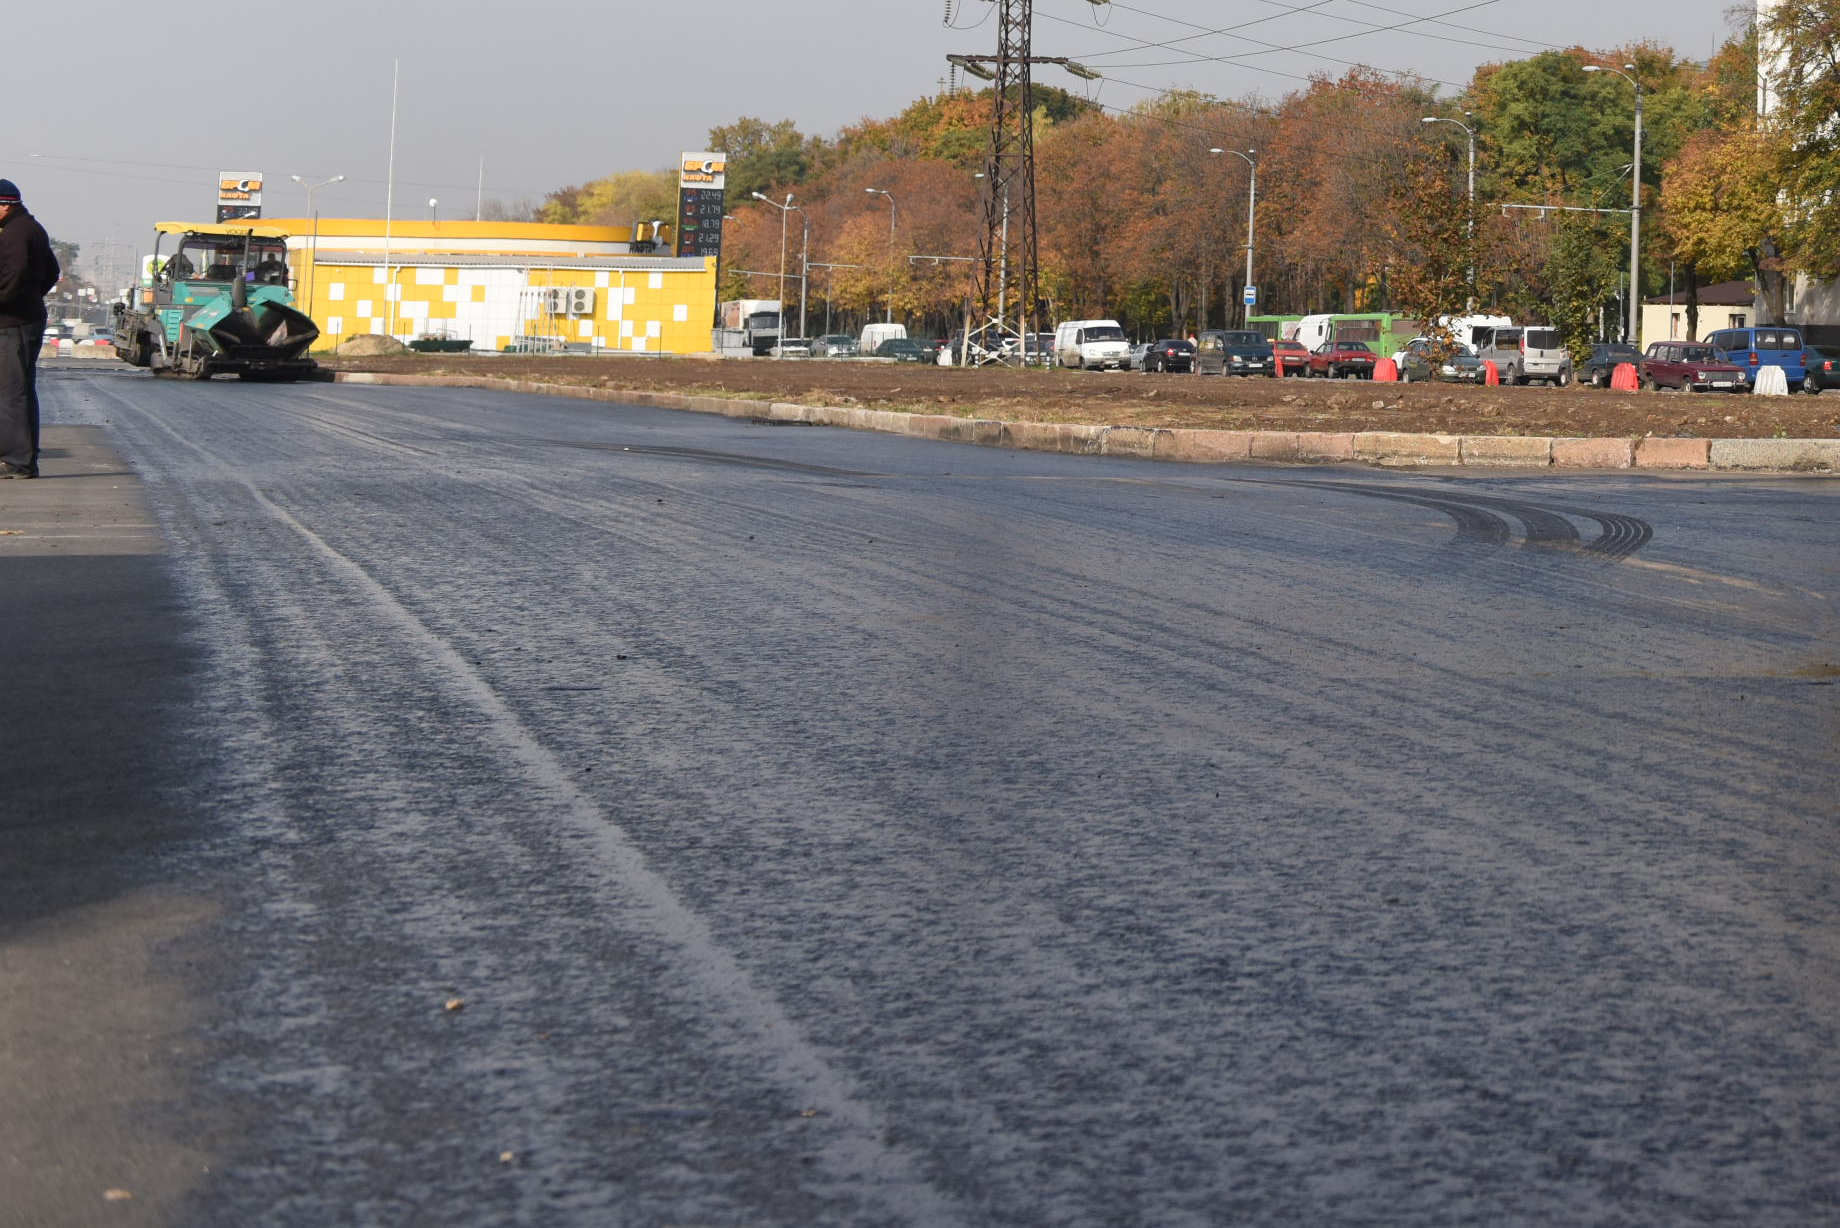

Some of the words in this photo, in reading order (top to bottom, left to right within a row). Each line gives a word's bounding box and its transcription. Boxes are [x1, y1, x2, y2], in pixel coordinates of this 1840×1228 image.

[684, 160, 725, 173] БРСМ
[682, 174, 713, 182] НАФТА
[219, 192, 249, 200] НАФТА
